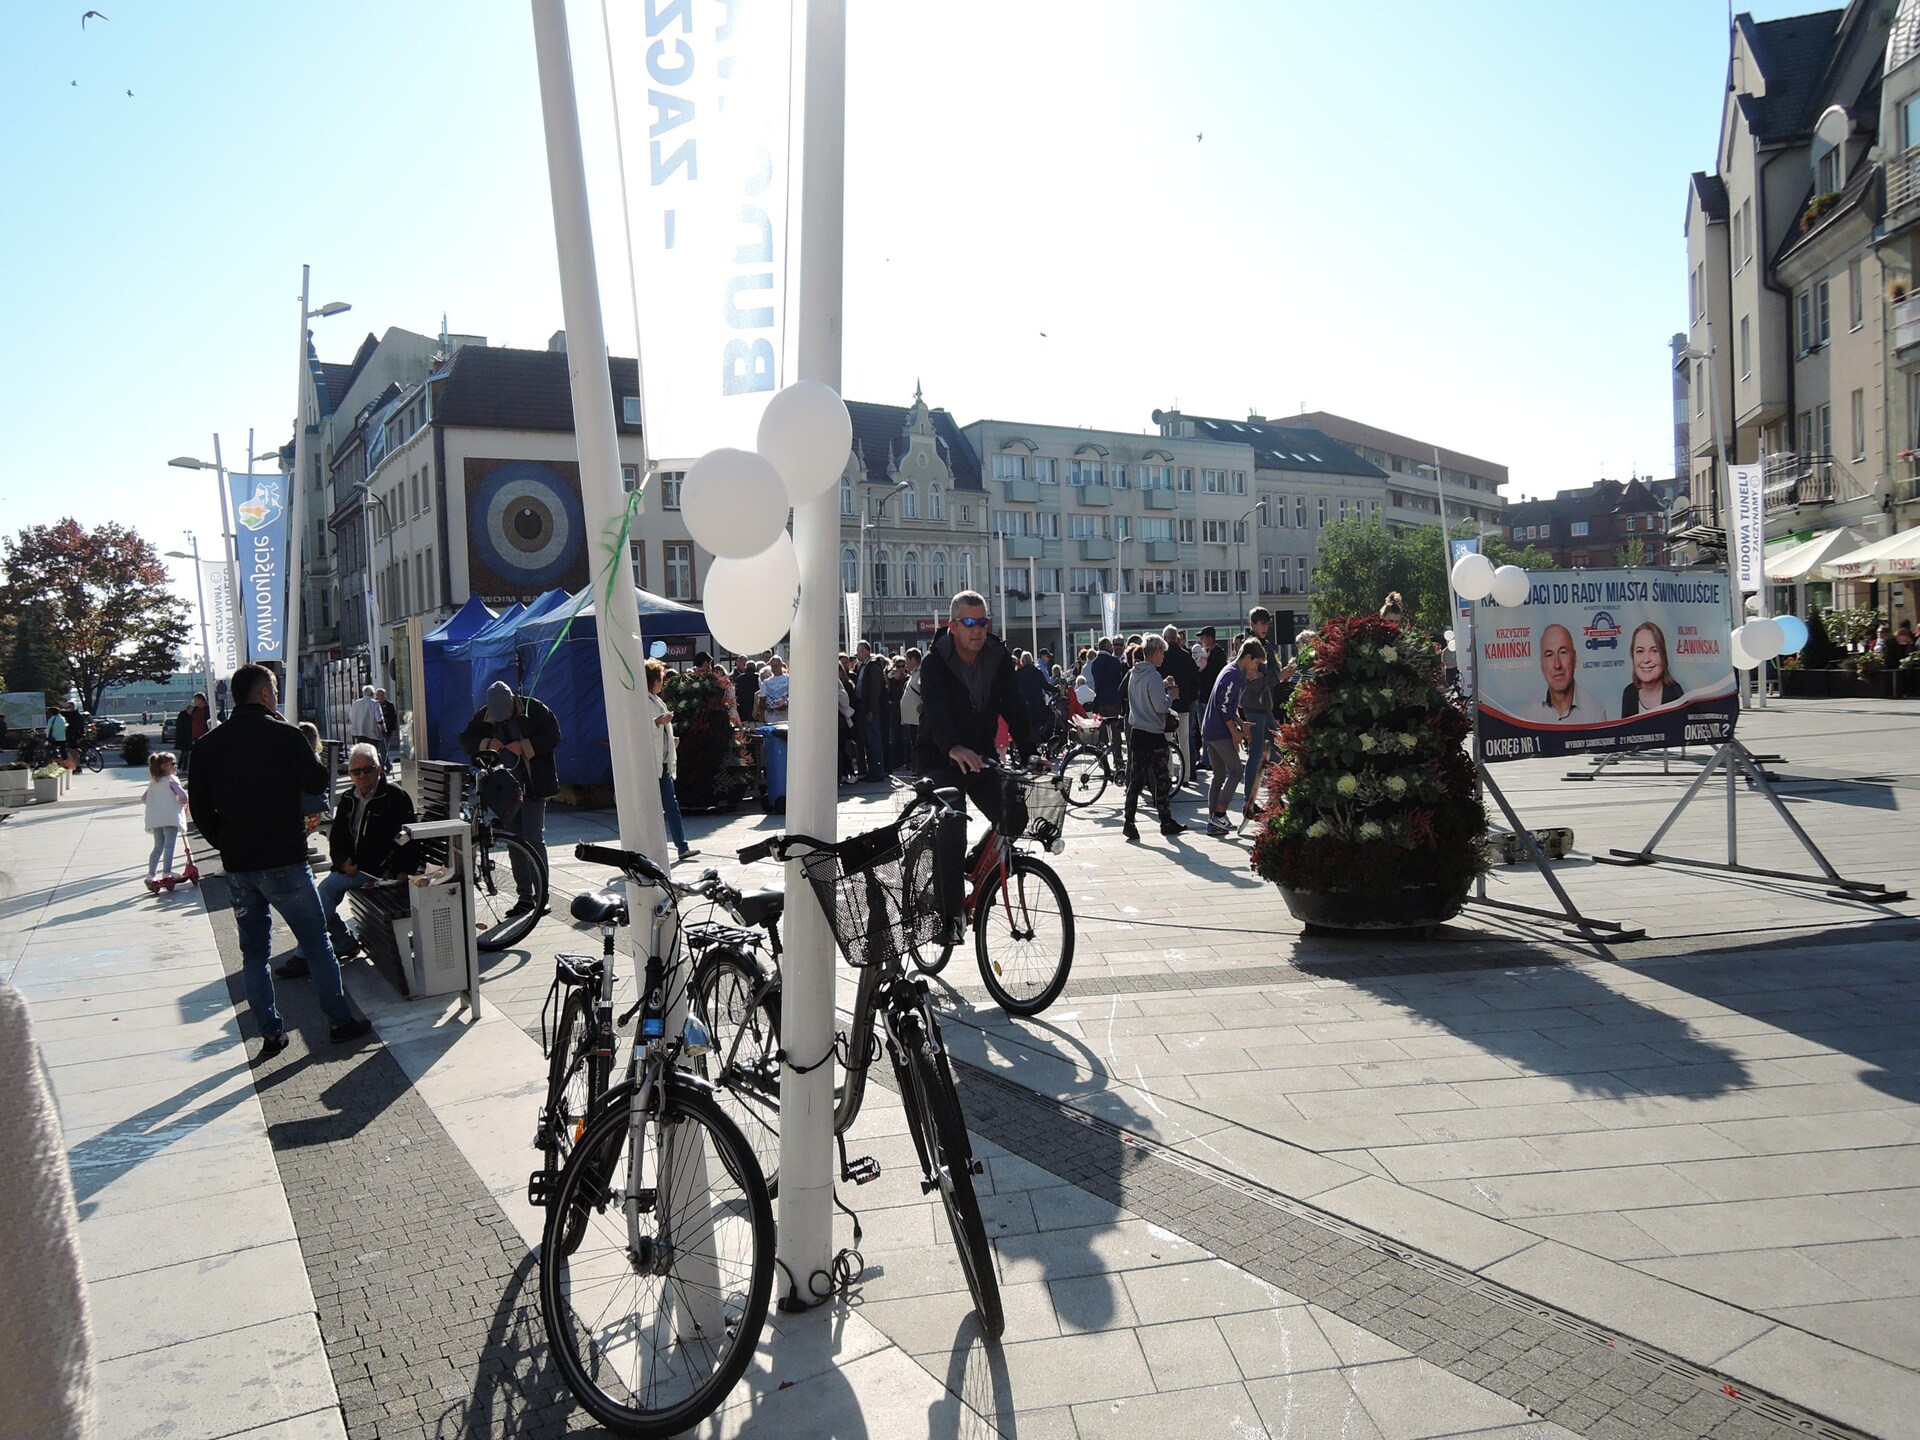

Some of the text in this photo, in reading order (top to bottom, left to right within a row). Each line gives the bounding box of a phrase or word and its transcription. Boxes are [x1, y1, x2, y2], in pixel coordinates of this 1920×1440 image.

[1738, 471, 1751, 582] BUDOWA TUNELU
[1751, 490, 1760, 553] ZACZYNAMY
[1837, 562, 1861, 576] TYSKIE
[1888, 558, 1916, 571] TYSKIE
[1553, 583, 1568, 604] DO
[1571, 582, 1602, 603] RADY
[1606, 581, 1649, 602] MIASTA
[1652, 578, 1720, 604] ŚWINOUJŚCIE
[1496, 627, 1531, 639] KRZYSZTOF
[1484, 639, 1531, 660] KAMIŃSKI
[1676, 636, 1720, 655] ŁAWIŃSKA
[1684, 723, 1731, 742] OKRĘG NR 2
[1485, 735, 1541, 758] OKRĘG NR 1
